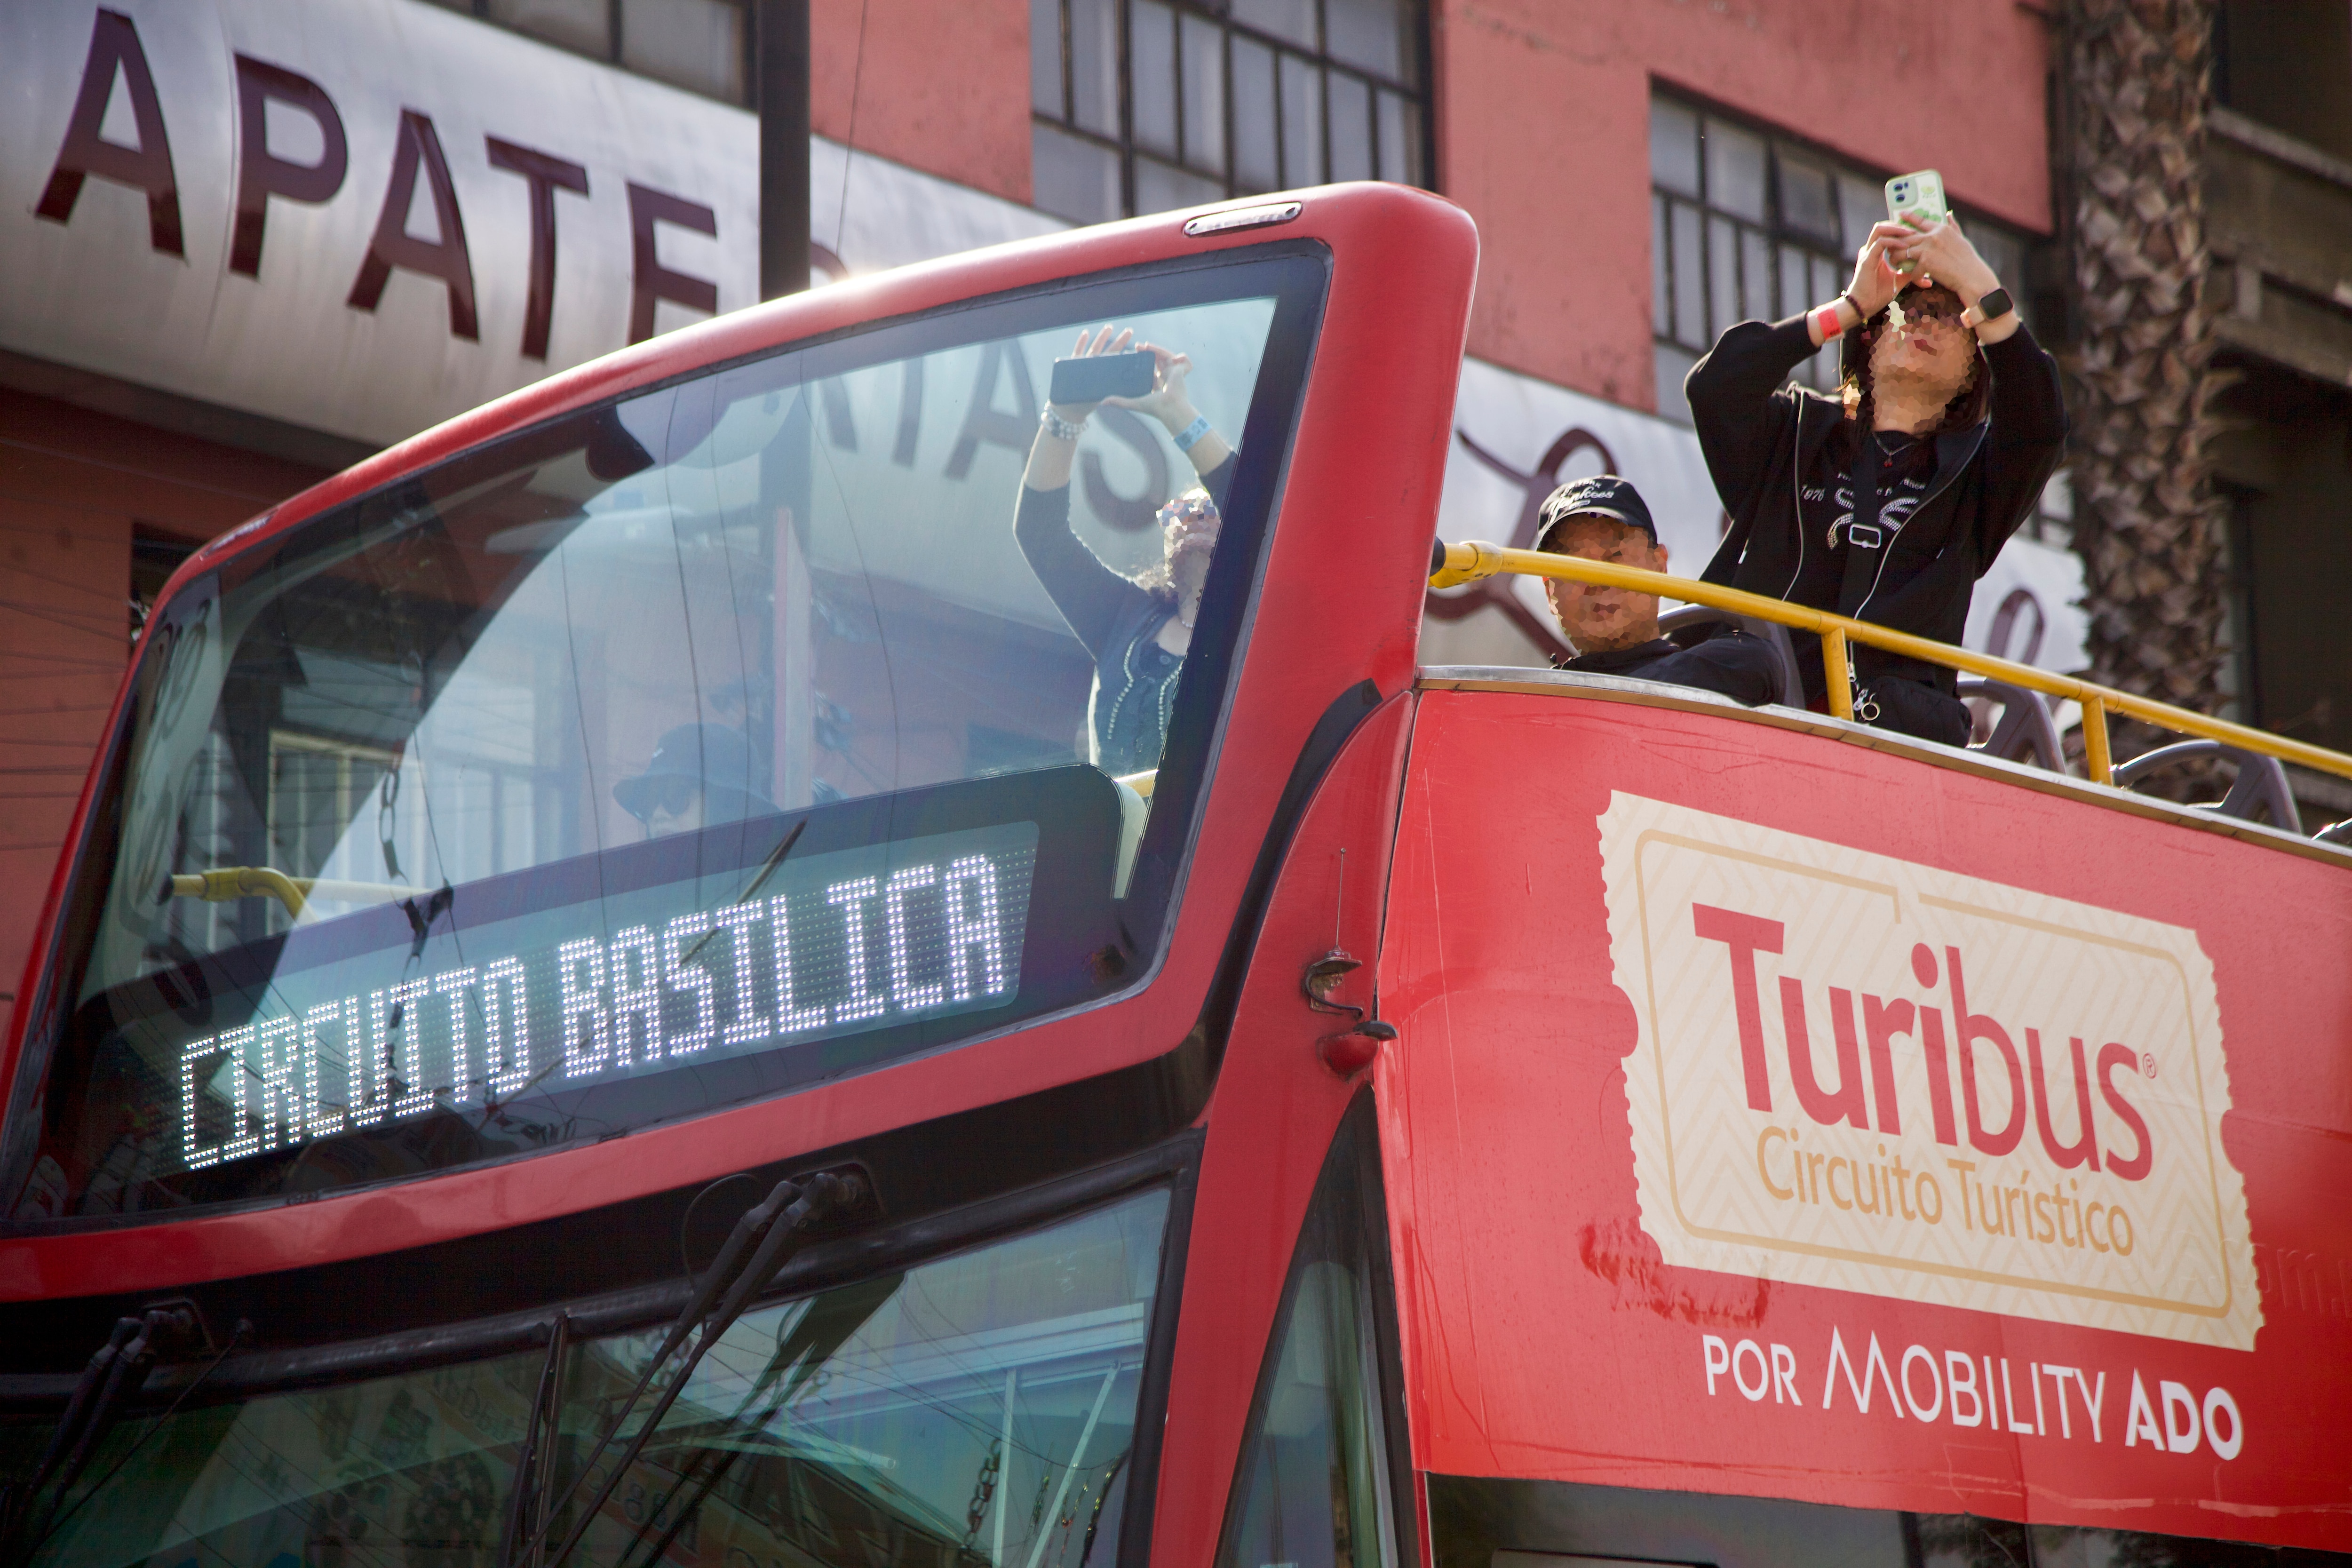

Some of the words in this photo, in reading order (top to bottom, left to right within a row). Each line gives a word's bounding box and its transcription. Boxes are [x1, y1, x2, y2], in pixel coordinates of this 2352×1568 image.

[180, 956, 530, 1170] CIRCUITO
[559, 854, 1004, 1079] BASILICA
[1756, 1126, 1942, 1225] Circuito
[1947, 1158, 2134, 1257] Turístico
[1702, 1334, 1802, 1406] POR
[1822, 1324, 2106, 1443] MOBILITY
[2125, 1368, 2243, 1461] ADO
